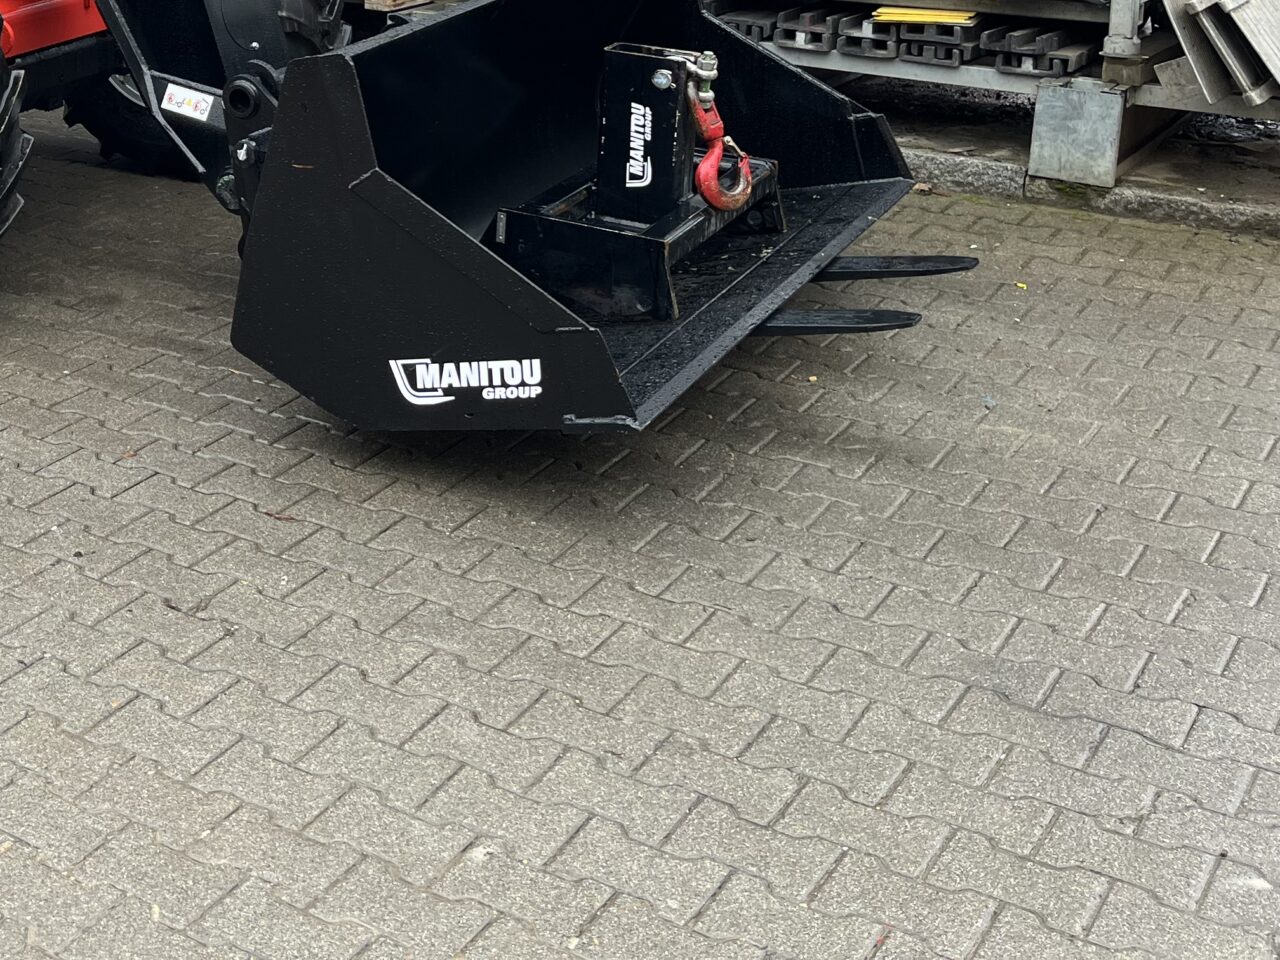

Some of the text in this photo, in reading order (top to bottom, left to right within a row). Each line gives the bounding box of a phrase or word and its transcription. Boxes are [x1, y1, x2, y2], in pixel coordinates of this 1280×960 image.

[629, 101, 645, 177] MANITOU
[644, 106, 653, 142] GROUP
[415, 358, 542, 389] MANITOU
[481, 385, 543, 400] GROUP
